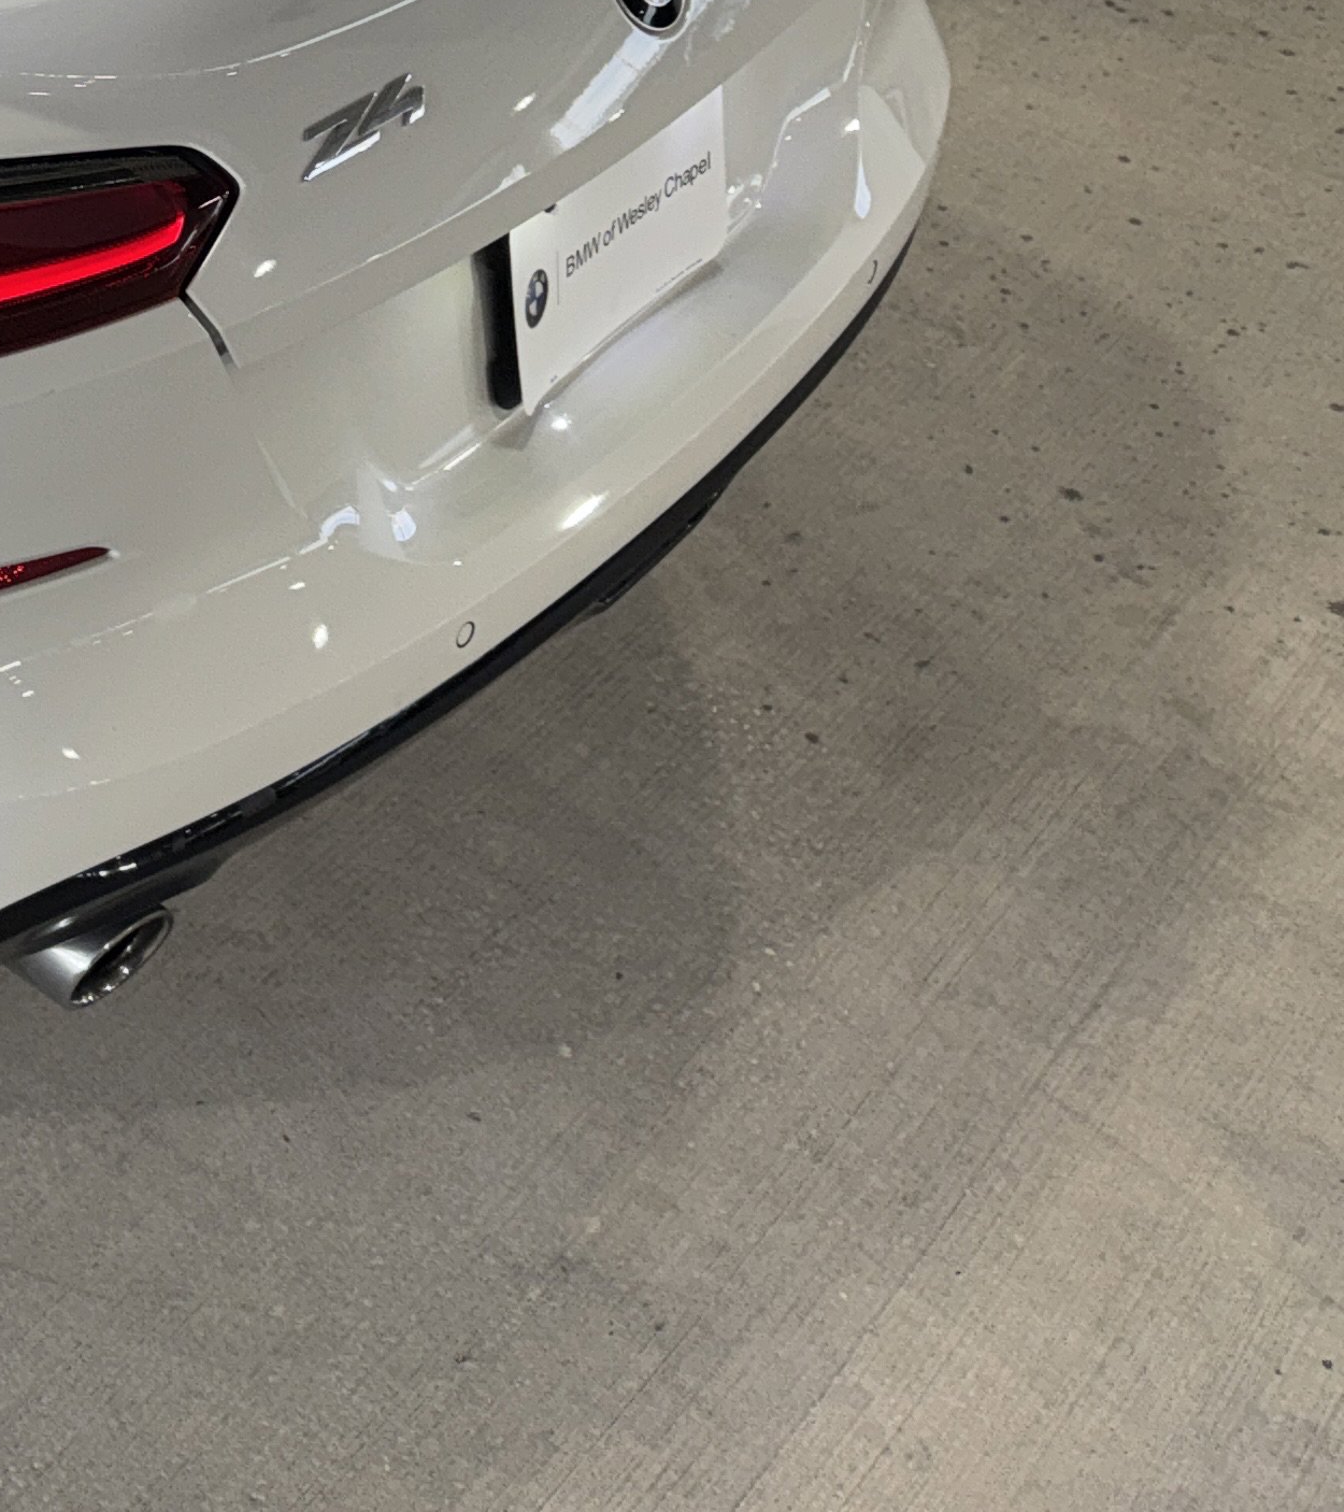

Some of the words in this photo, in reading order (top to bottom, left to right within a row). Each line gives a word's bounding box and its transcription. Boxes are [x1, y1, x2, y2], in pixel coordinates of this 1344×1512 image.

[302, 72, 425, 182] Z4
[565, 231, 602, 278] BMW
[602, 220, 617, 247] of
[617, 189, 662, 235] Wesley
[664, 151, 712, 198] Chapel
